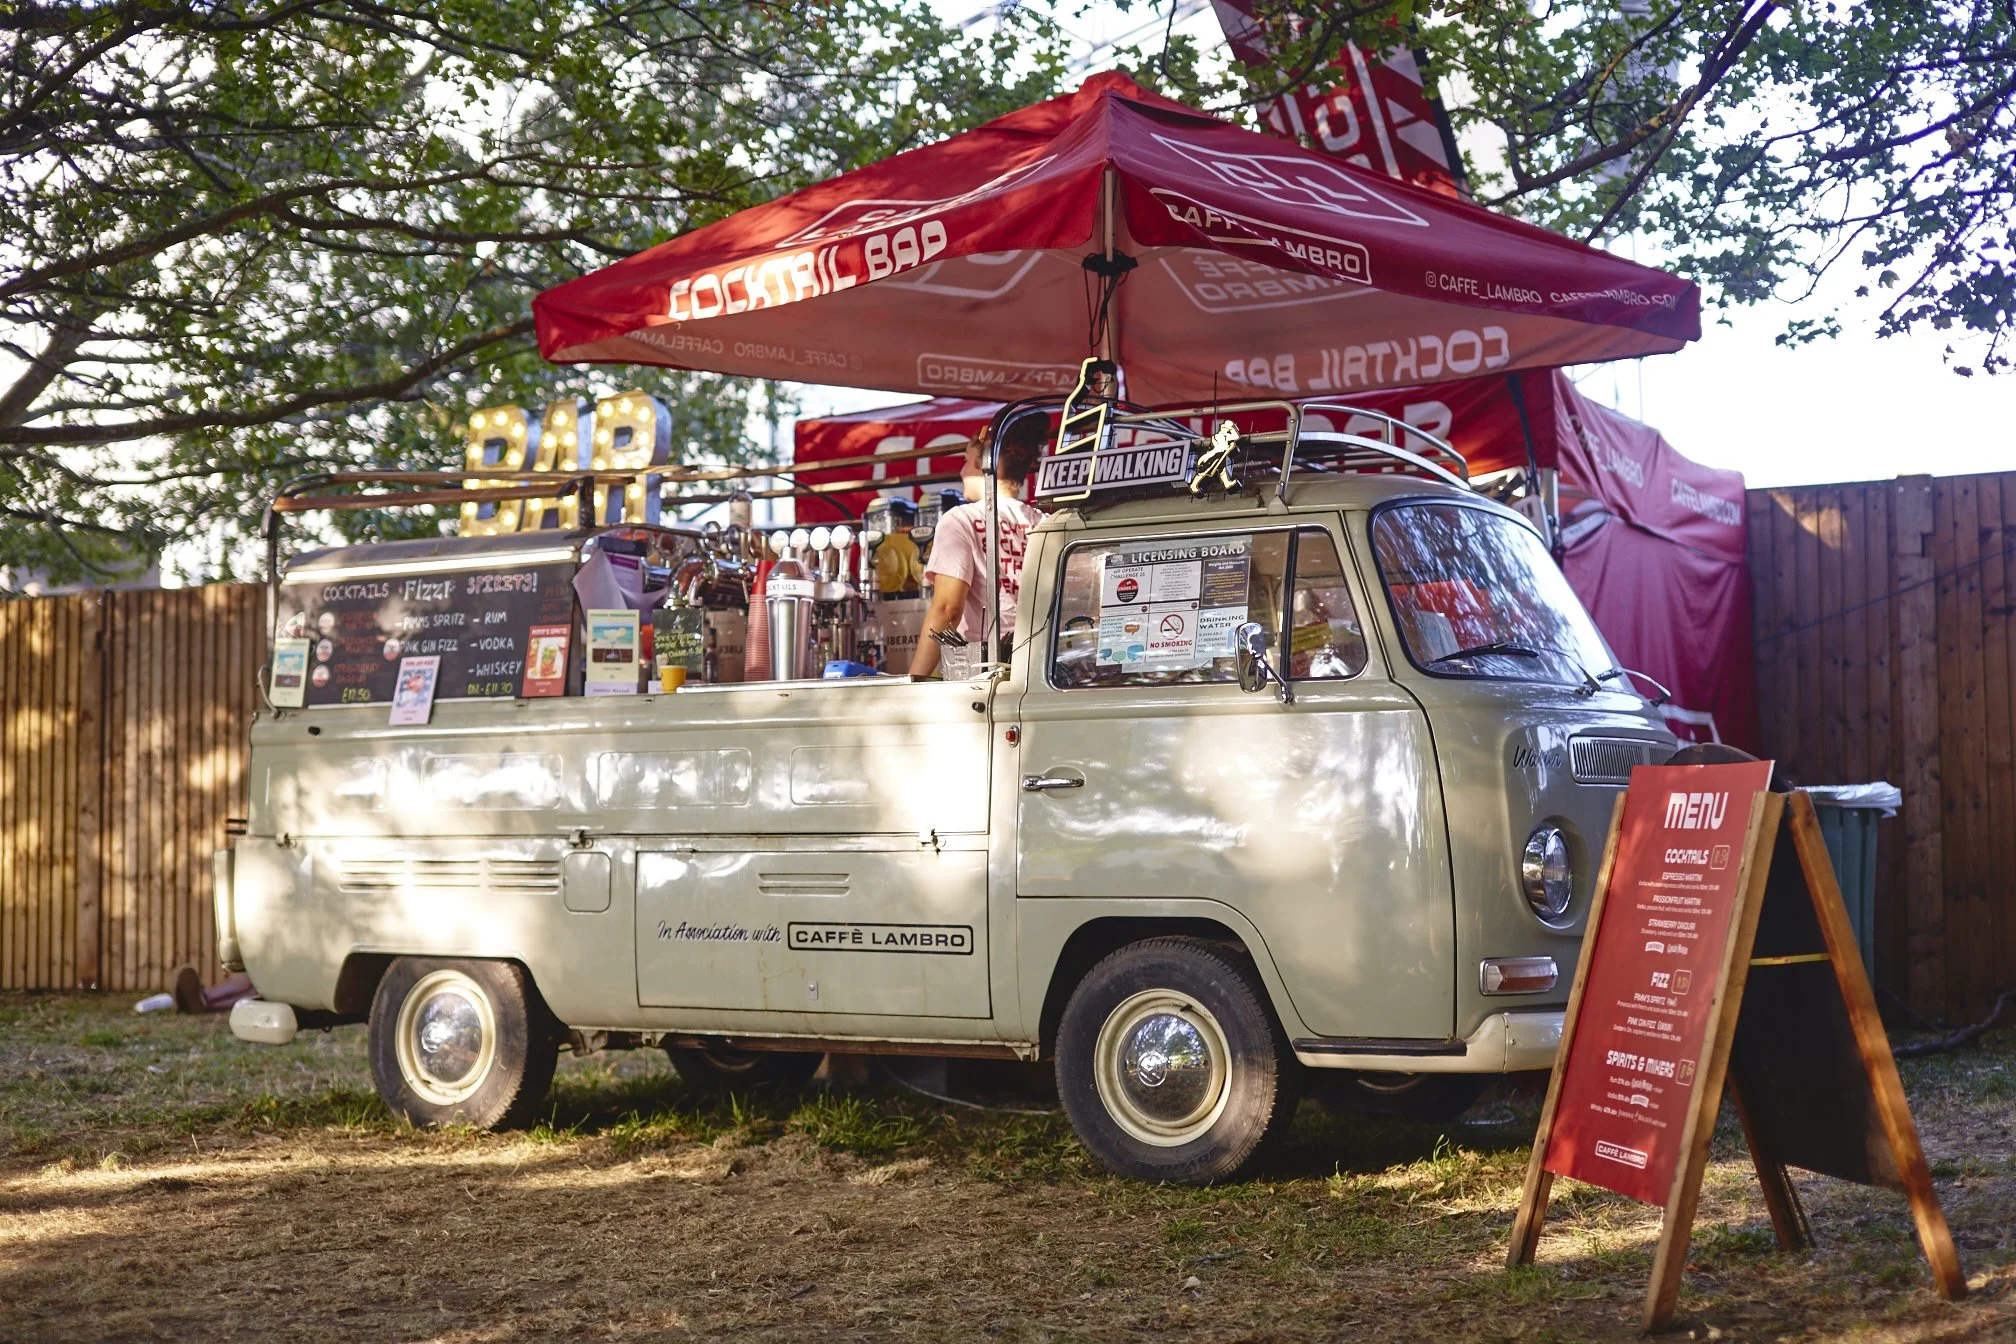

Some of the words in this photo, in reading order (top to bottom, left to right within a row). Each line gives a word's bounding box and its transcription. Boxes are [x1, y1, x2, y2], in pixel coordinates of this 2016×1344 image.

[1271, 237, 1362, 274] AMBRO
[668, 244, 856, 321] COCKTAIL
[1440, 273, 1543, 304] CAFFE_LAMBRO
[459, 391, 672, 537] BAR
[1043, 458, 1092, 489] KEEP
[1094, 448, 1182, 483] WALKING
[1131, 548, 1197, 563] LICENSING
[1201, 544, 1245, 557] BOARD
[323, 582, 389, 601] COCKTAILS
[467, 572, 537, 595] SPIRITS!
[433, 612, 465, 626] SPRITZ
[485, 611, 507, 625] RUM
[1200, 615, 1245, 624] DRINKING
[422, 639, 436, 653] GIN
[438, 638, 458, 652] FIZZ
[1161, 640, 1193, 648] SMOKING
[1664, 791, 1729, 830] MENU
[1664, 848, 1709, 865] COCKTAILS
[657, 919, 672, 940] In
[675, 921, 748, 942] Association
[752, 924, 781, 942] with
[795, 928, 863, 945] CAFFÈ
[871, 931, 965, 948] LAMBRO
[1650, 971, 1670, 988] FIZZ
[1606, 1050, 1638, 1070] SPIRITS
[1637, 1056, 1645, 1072] &
[1645, 1058, 1675, 1078] MIXERS
[1619, 1151, 1645, 1165] LAMBRO
